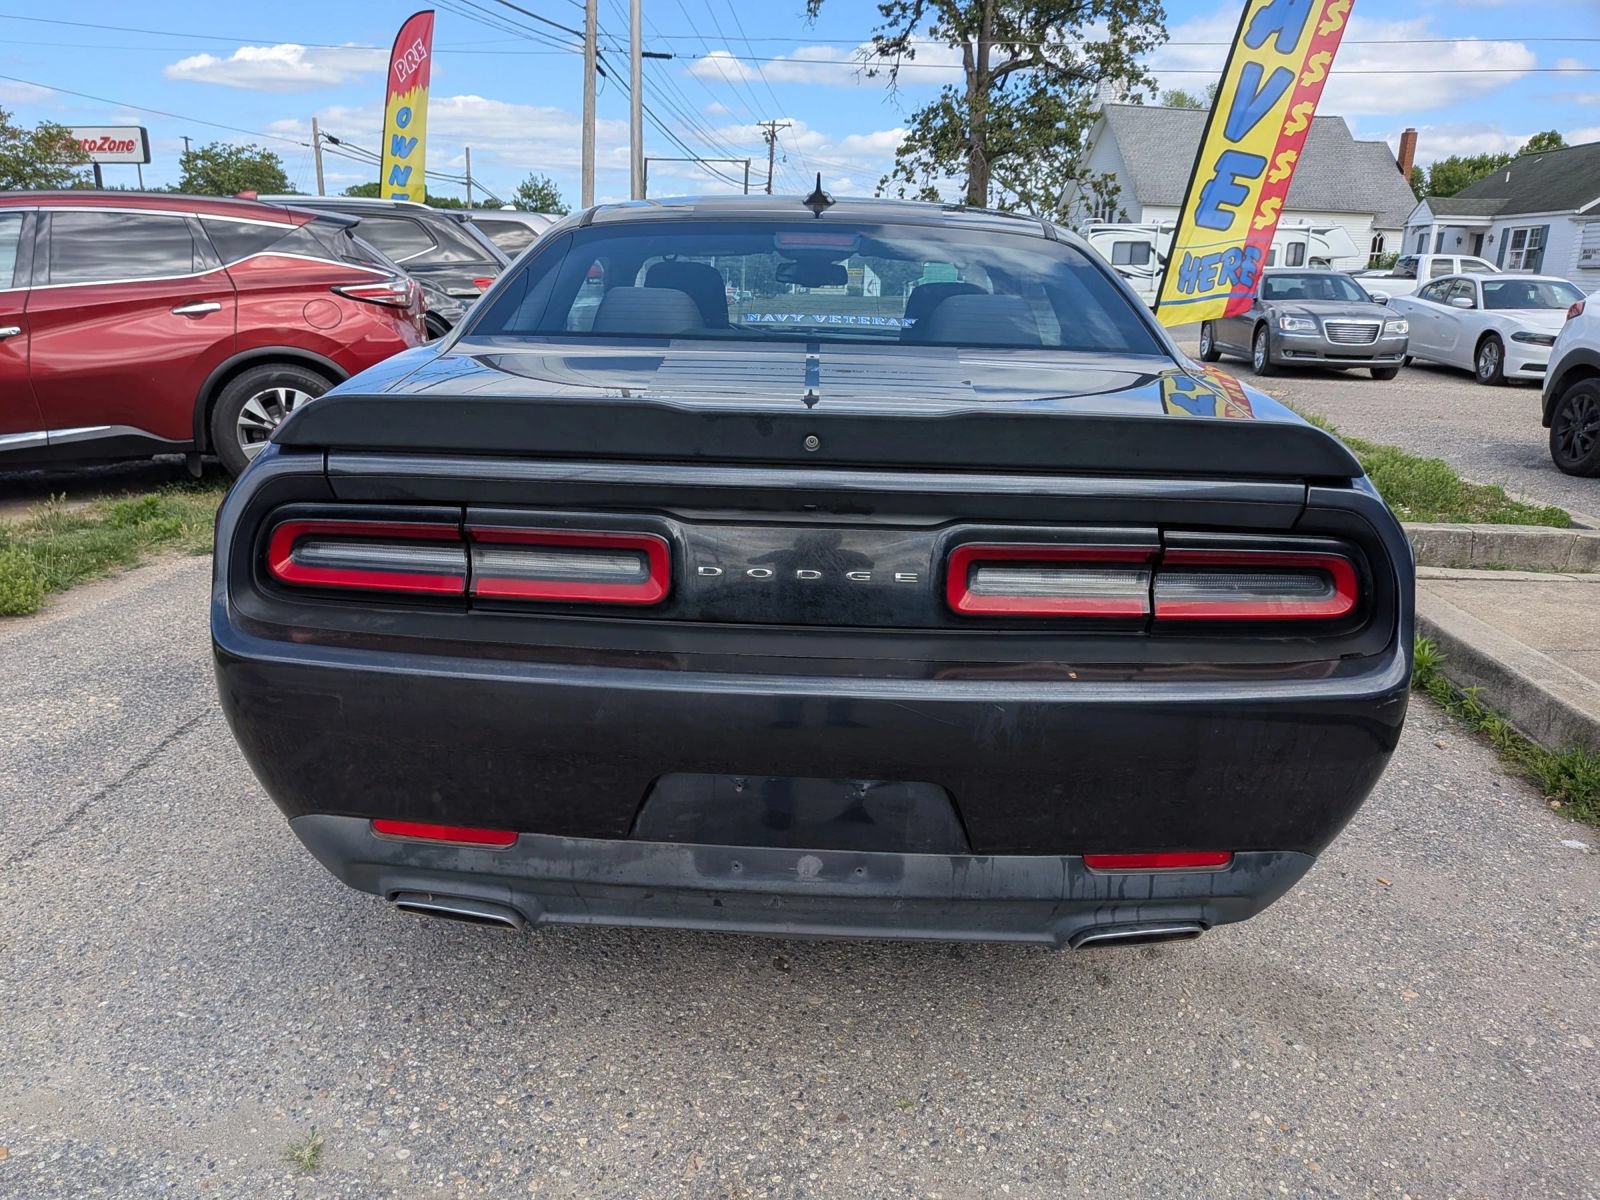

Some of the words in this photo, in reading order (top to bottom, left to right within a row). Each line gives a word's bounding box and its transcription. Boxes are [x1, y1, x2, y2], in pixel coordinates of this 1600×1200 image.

[394, 38, 427, 82] PRE
[1177, 245, 1261, 294] HERE
[746, 313, 805, 323] NAVY
[812, 314, 919, 328] VETERAN
[698, 566, 919, 583] DODGE
